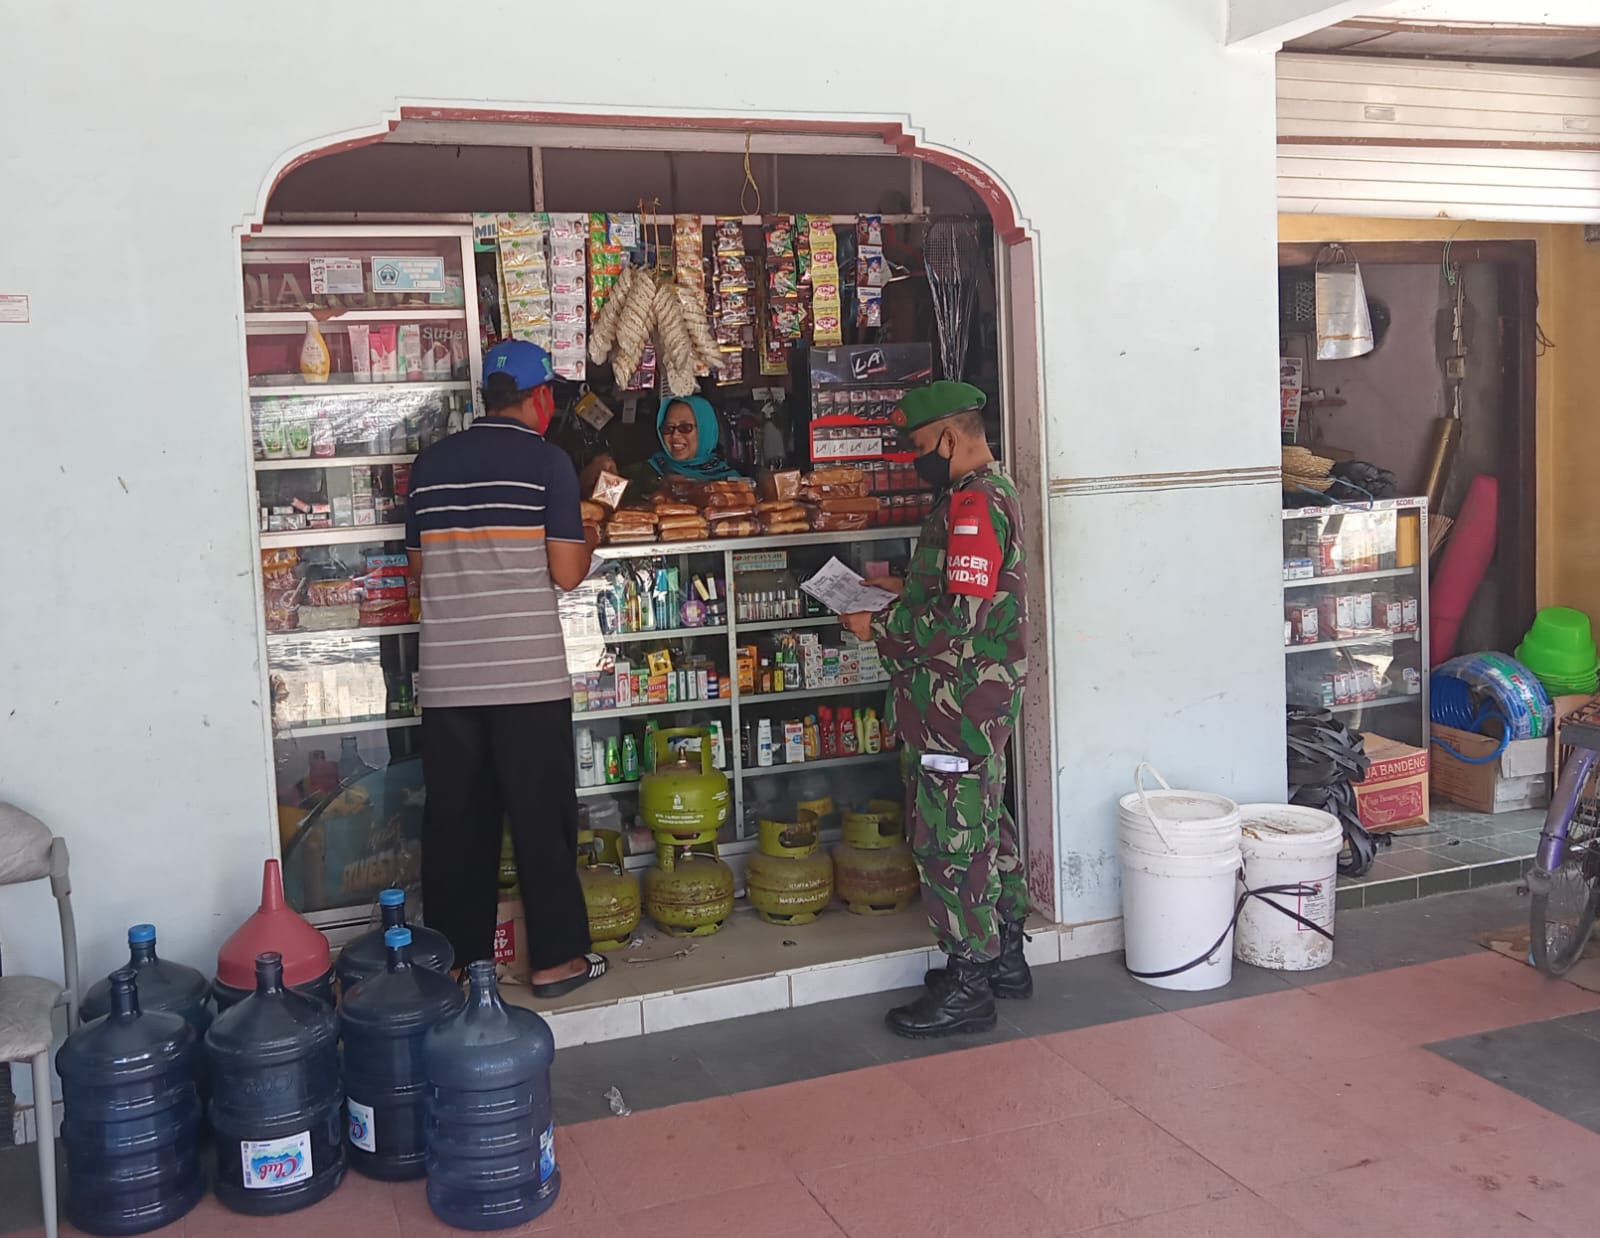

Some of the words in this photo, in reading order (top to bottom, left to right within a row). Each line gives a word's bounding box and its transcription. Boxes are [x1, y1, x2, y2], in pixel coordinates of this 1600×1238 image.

[855, 351, 880, 373] LA
[1380, 756, 1426, 776] BANDENG
[259, 1156, 298, 1181] Club
